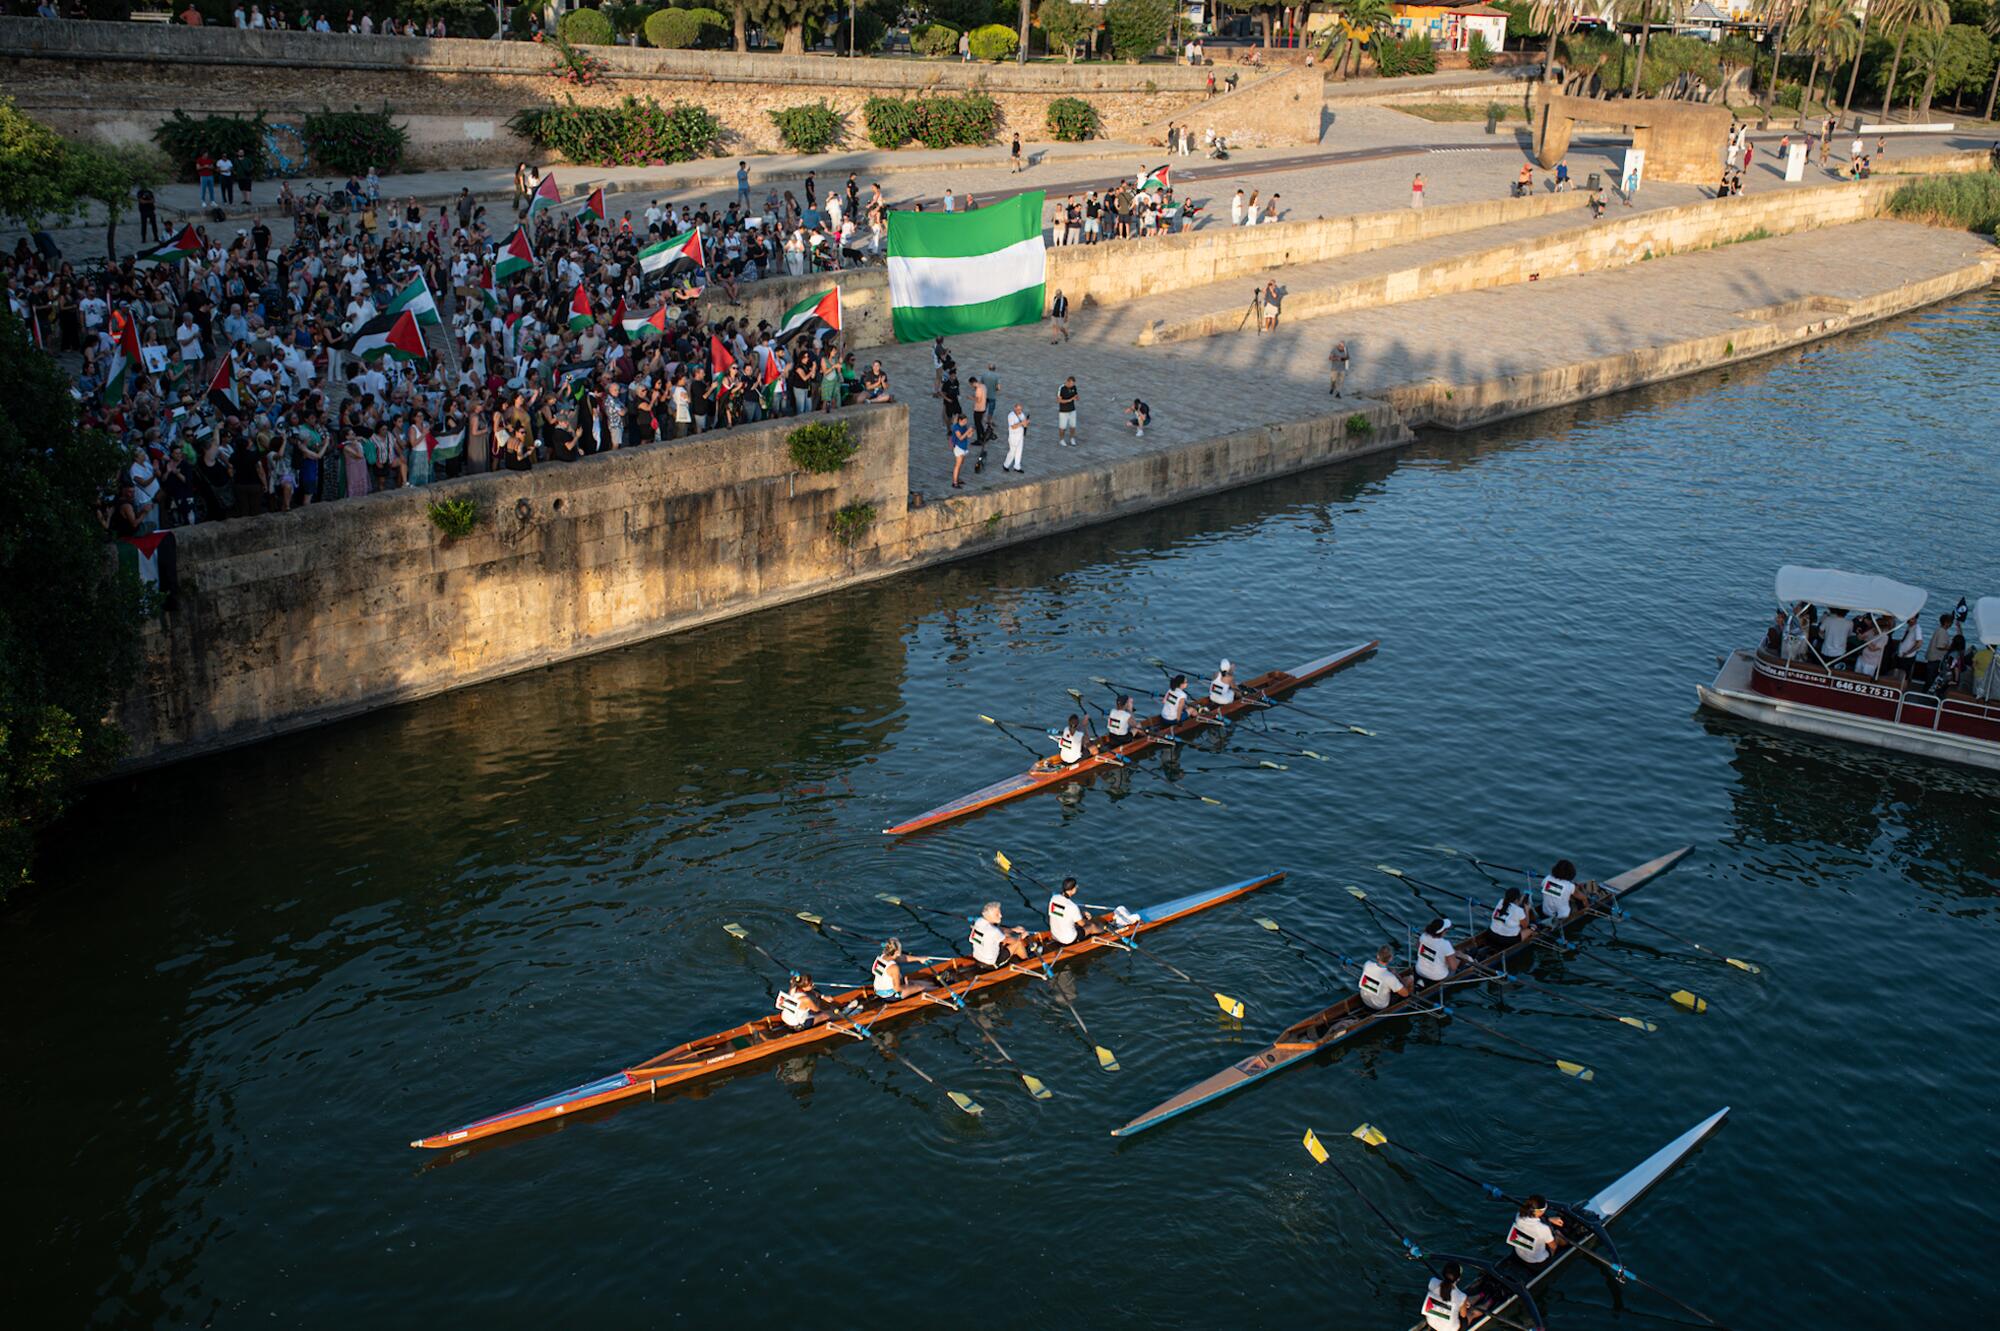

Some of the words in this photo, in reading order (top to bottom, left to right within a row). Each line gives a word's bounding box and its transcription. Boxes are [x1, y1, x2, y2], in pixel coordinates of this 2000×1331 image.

[1836, 680, 1854, 691] 646
[1855, 684, 1868, 693] 62
[1869, 686, 1881, 696] 75
[1882, 689, 1894, 698] 31
